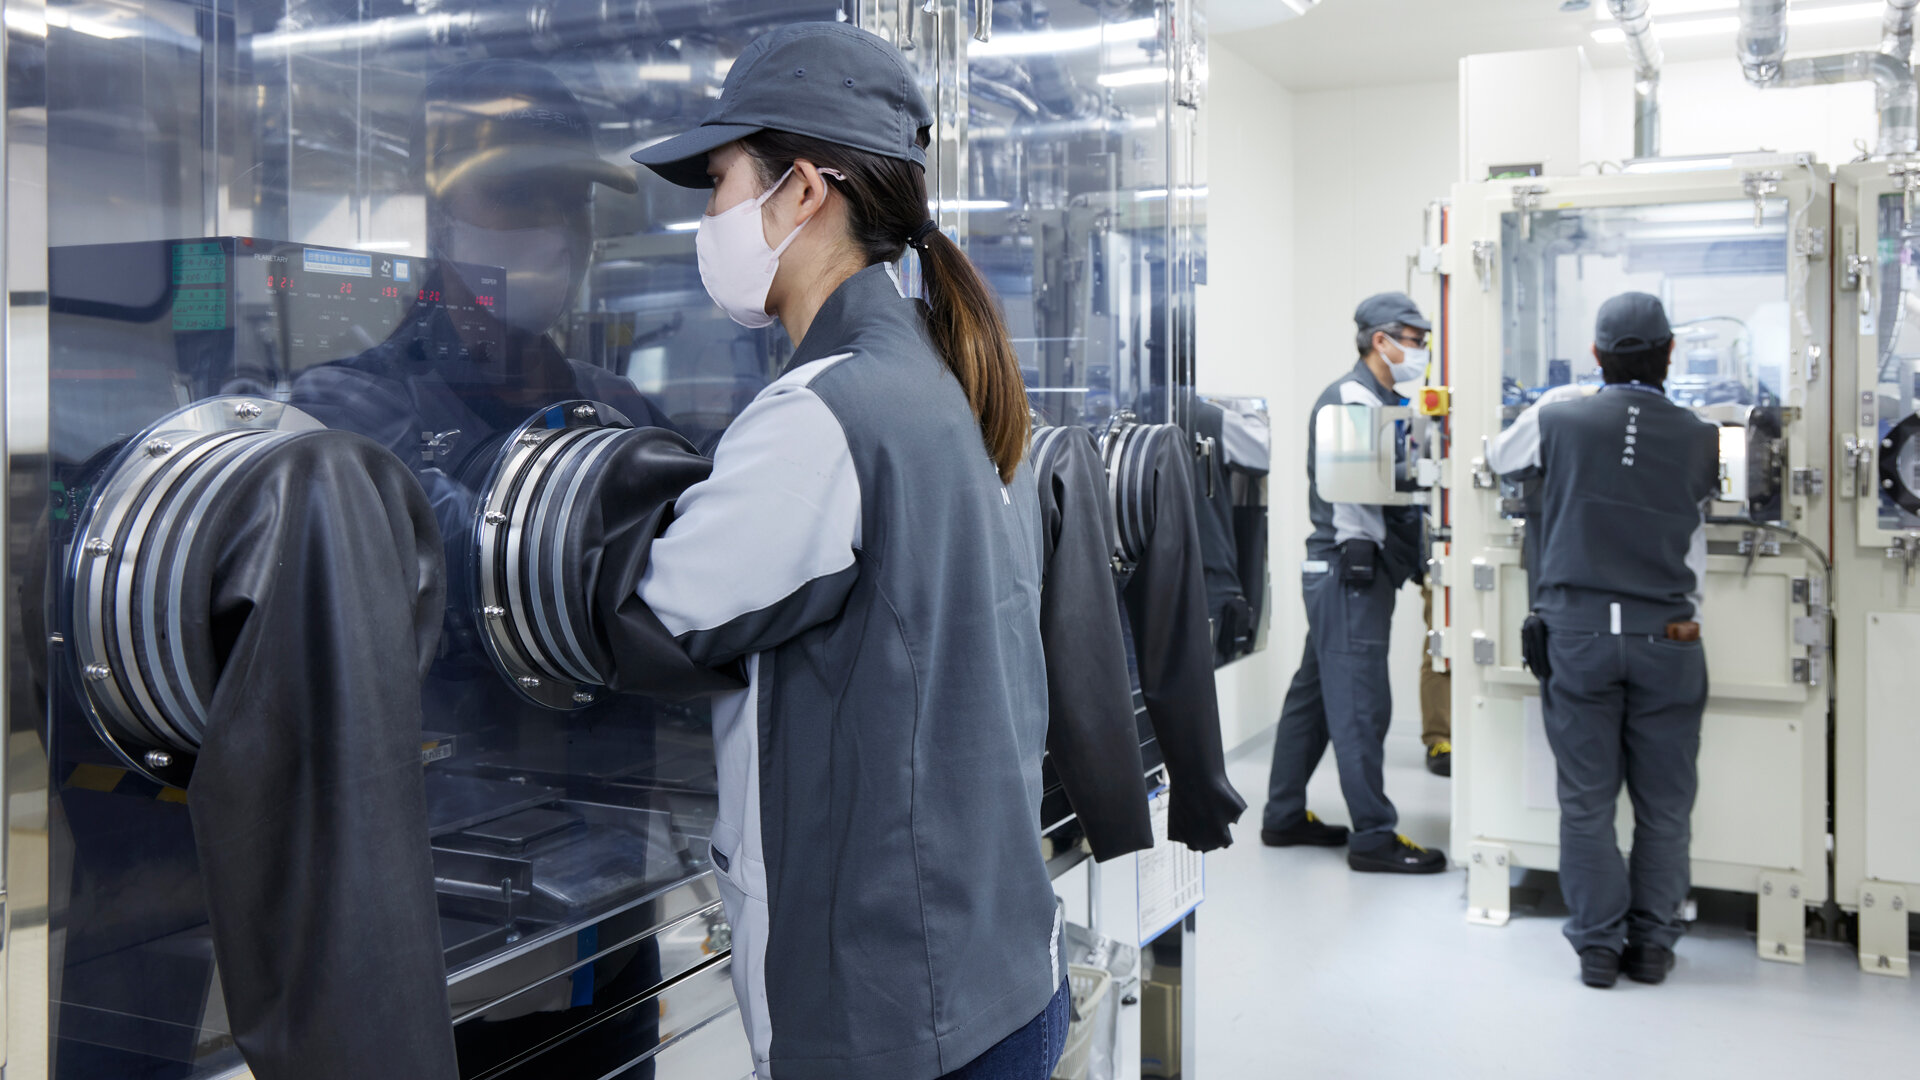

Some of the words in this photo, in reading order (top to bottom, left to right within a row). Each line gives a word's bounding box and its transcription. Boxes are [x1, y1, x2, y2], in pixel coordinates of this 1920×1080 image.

[254, 253, 288, 263] PLANETARY
[340, 282, 352, 294] 20
[1621, 405, 1640, 467] NISSAN
